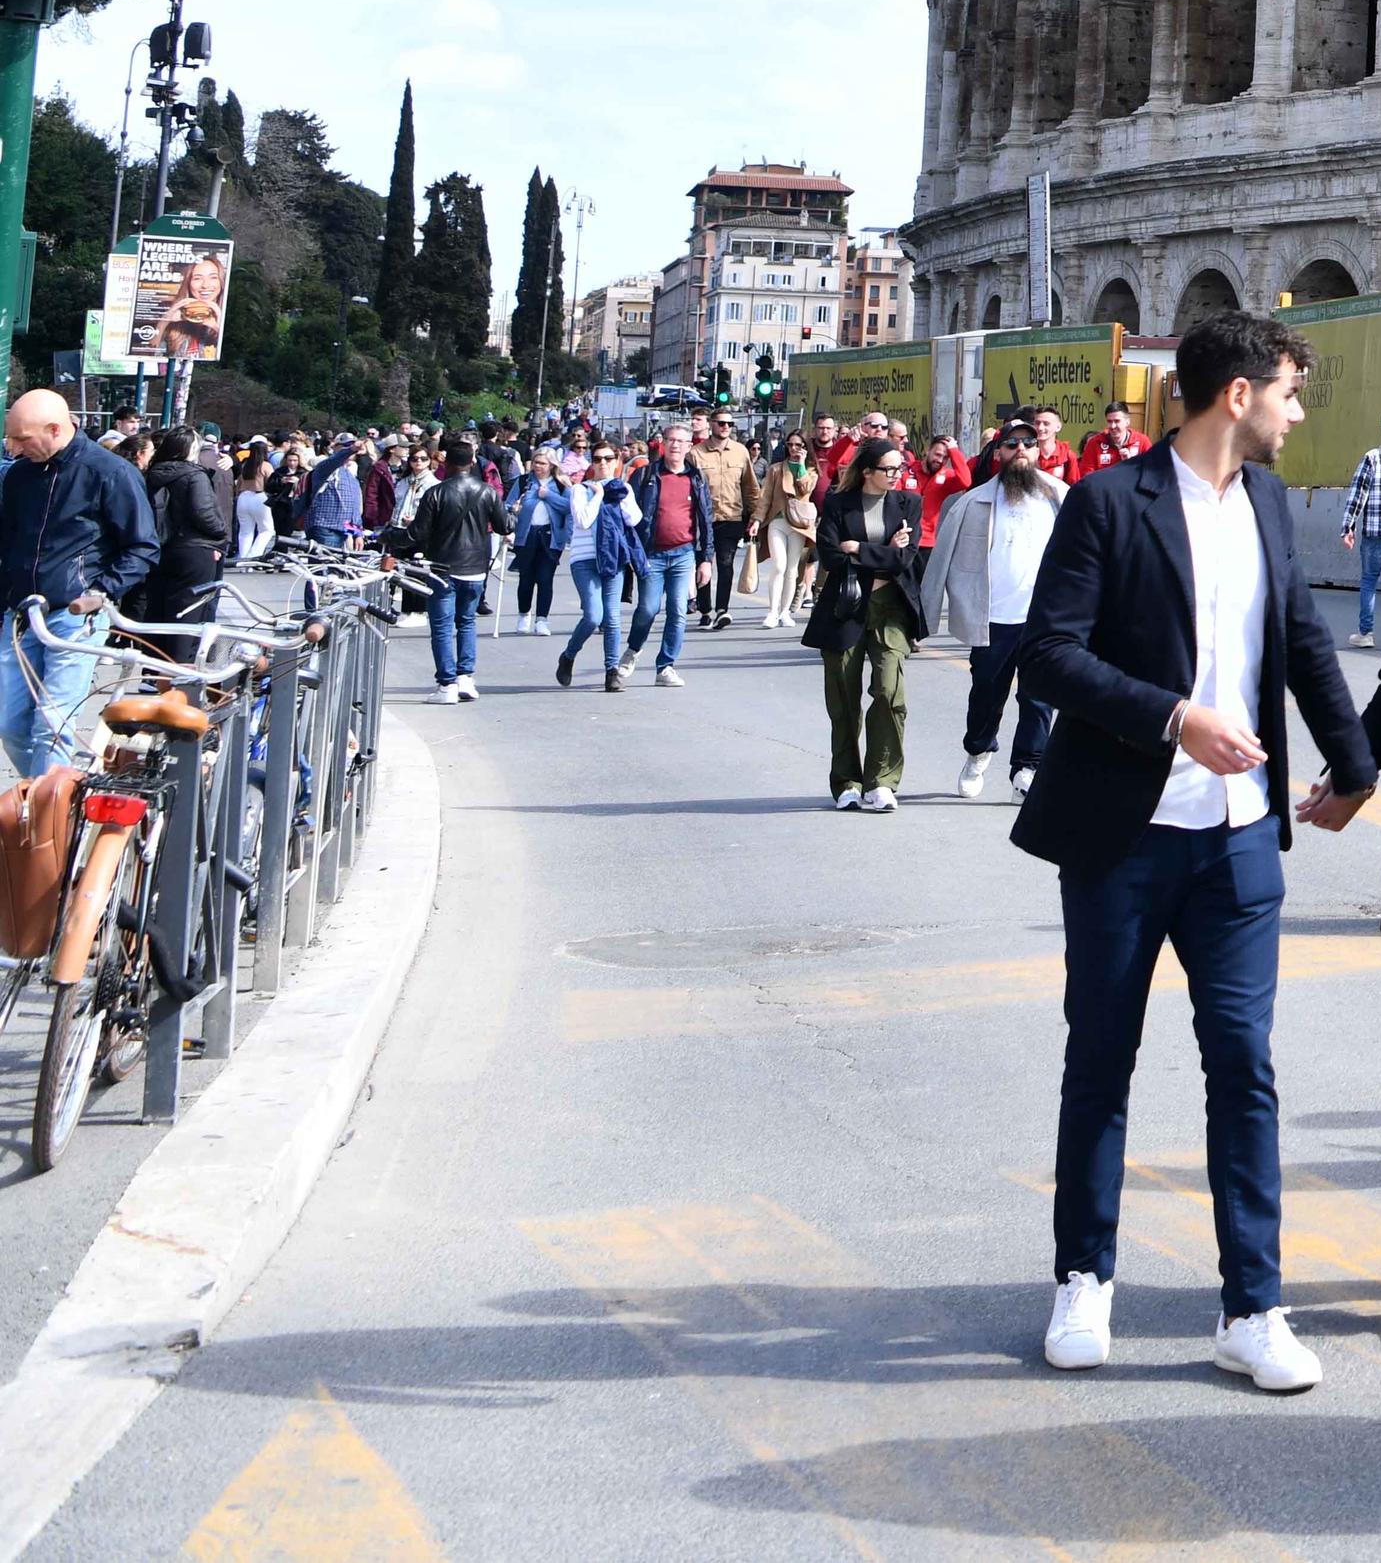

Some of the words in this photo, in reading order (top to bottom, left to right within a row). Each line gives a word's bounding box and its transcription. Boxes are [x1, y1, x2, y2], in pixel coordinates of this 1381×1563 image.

[142, 251, 204, 264] LEGENDS
[144, 241, 193, 254] WHERE
[141, 261, 169, 272] ARE
[1029, 354, 1091, 391] Biglietterie
[830, 372, 859, 397] Colosseo
[860, 371, 890, 400] ingresso
[891, 368, 914, 393] Stern
[1062, 394, 1095, 425] Office
